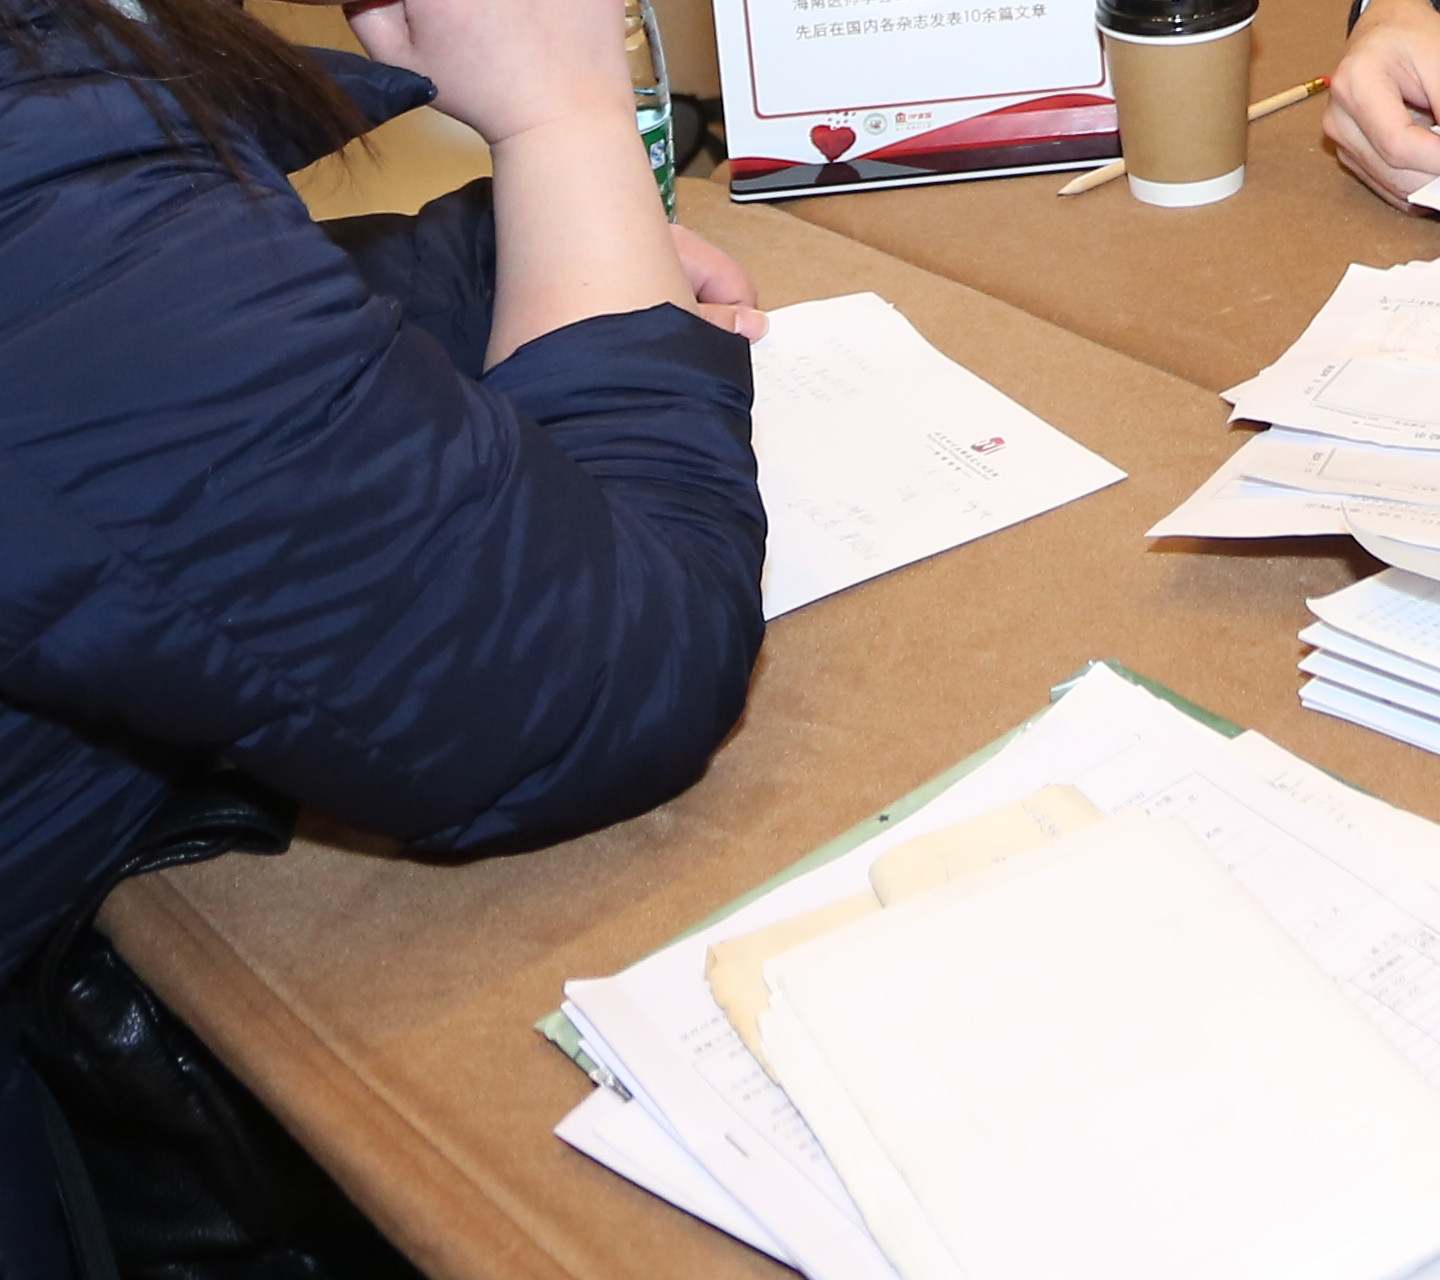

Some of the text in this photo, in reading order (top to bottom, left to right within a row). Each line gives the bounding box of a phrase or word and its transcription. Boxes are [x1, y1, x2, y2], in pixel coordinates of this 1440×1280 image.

[795, 3, 1047, 40] 先后在国内各杂志发表10余篇文章
